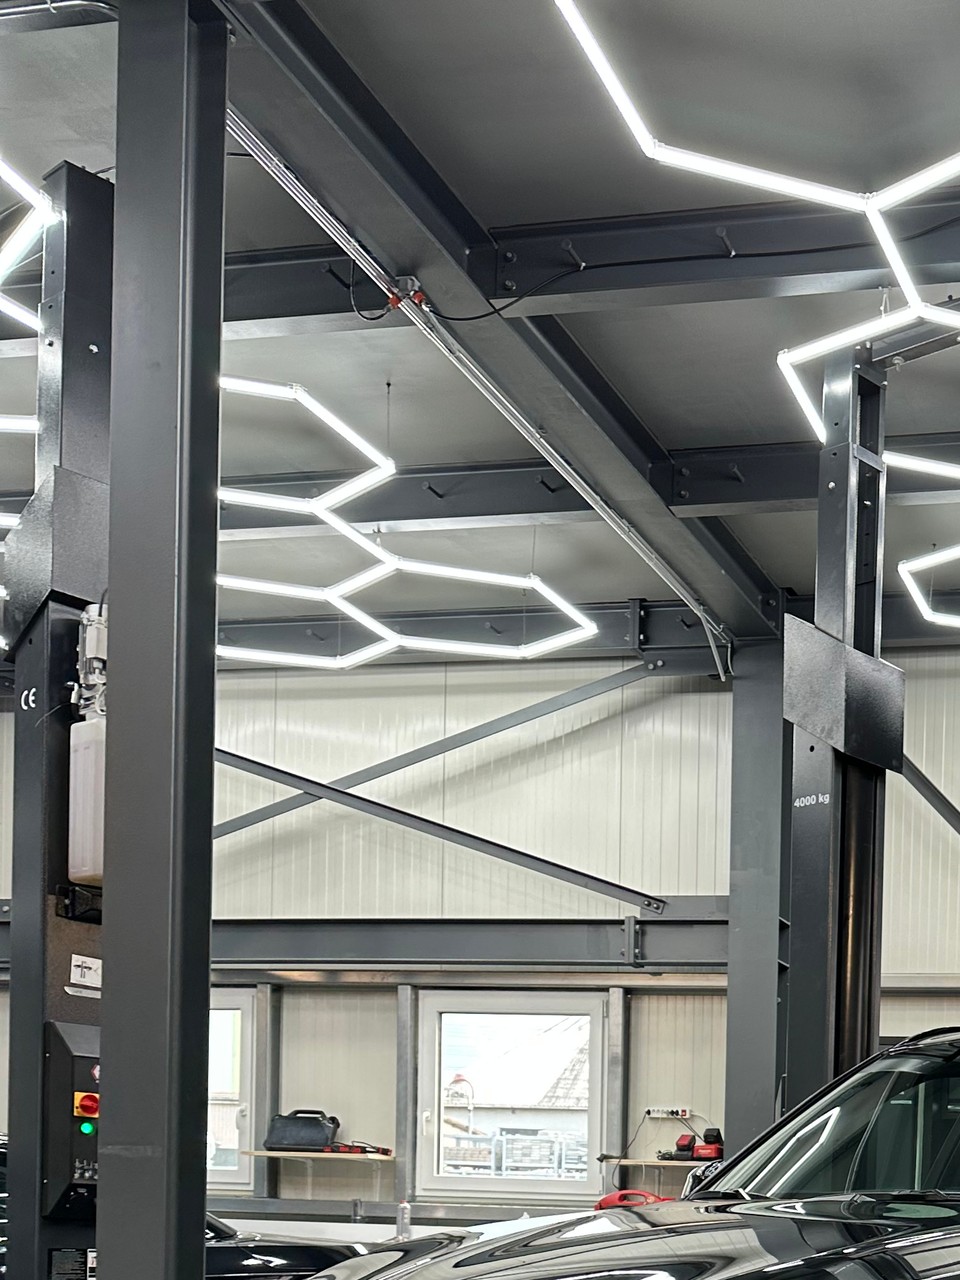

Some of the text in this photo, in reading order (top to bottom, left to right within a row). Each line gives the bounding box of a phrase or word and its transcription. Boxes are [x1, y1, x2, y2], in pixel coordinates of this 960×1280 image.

[21, 687, 36, 710] CE
[793, 793, 830, 808] 4000 kg
